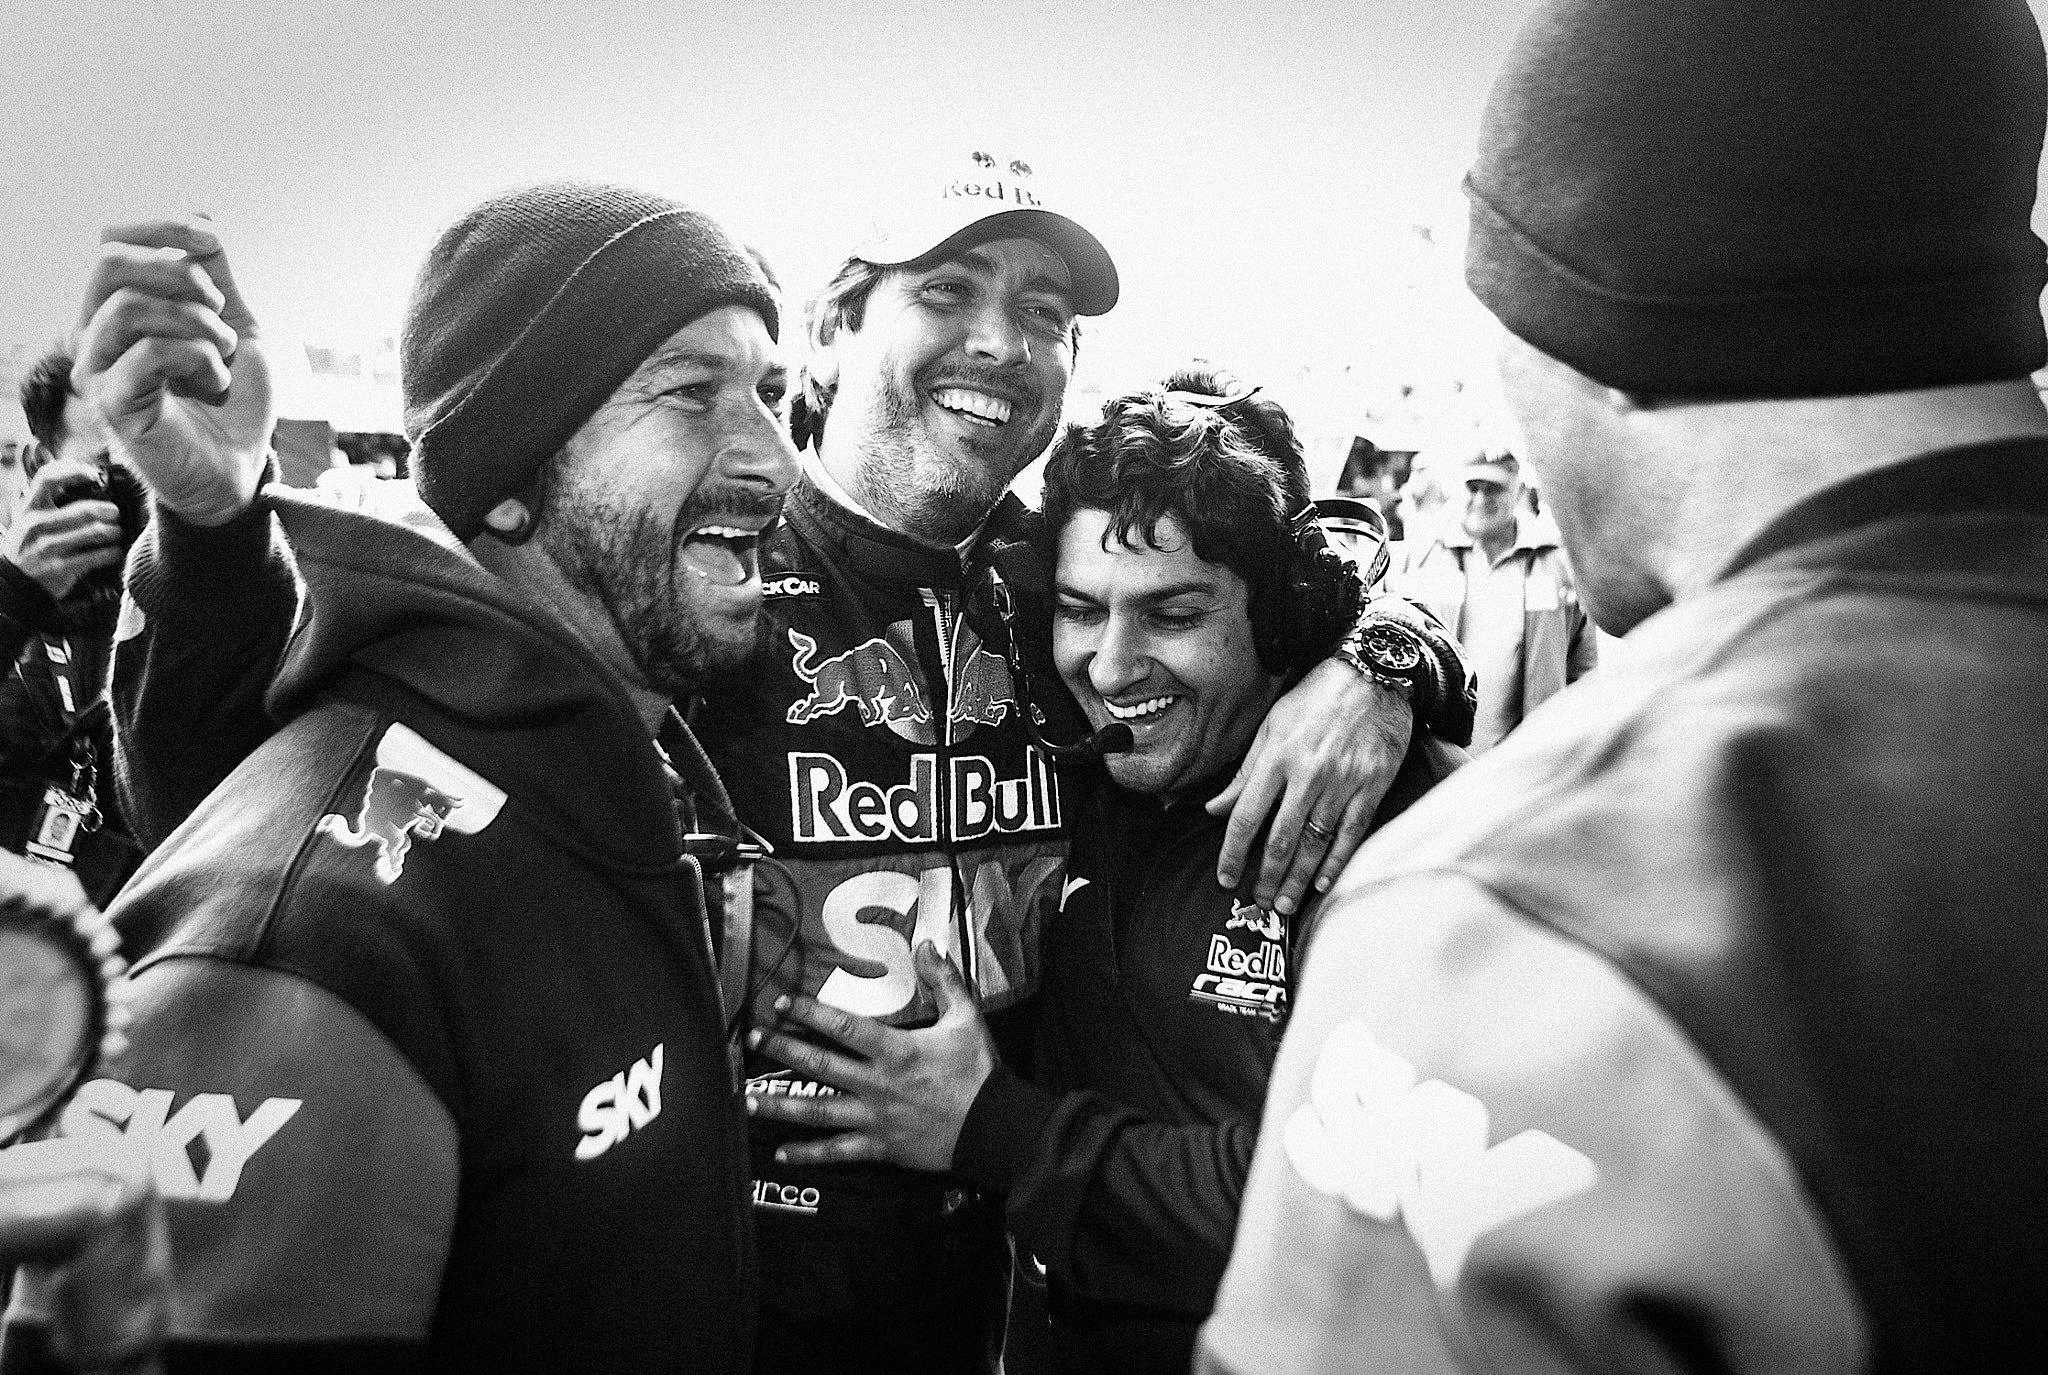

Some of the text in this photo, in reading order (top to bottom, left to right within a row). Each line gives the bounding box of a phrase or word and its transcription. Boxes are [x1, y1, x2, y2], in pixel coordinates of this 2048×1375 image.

[787, 745, 1062, 843] Red Bull
[816, 856, 1066, 1018] SKY
[1206, 933, 1271, 979] Red
[60, 1077, 303, 1202] SKY
[574, 1041, 664, 1161] SKY
